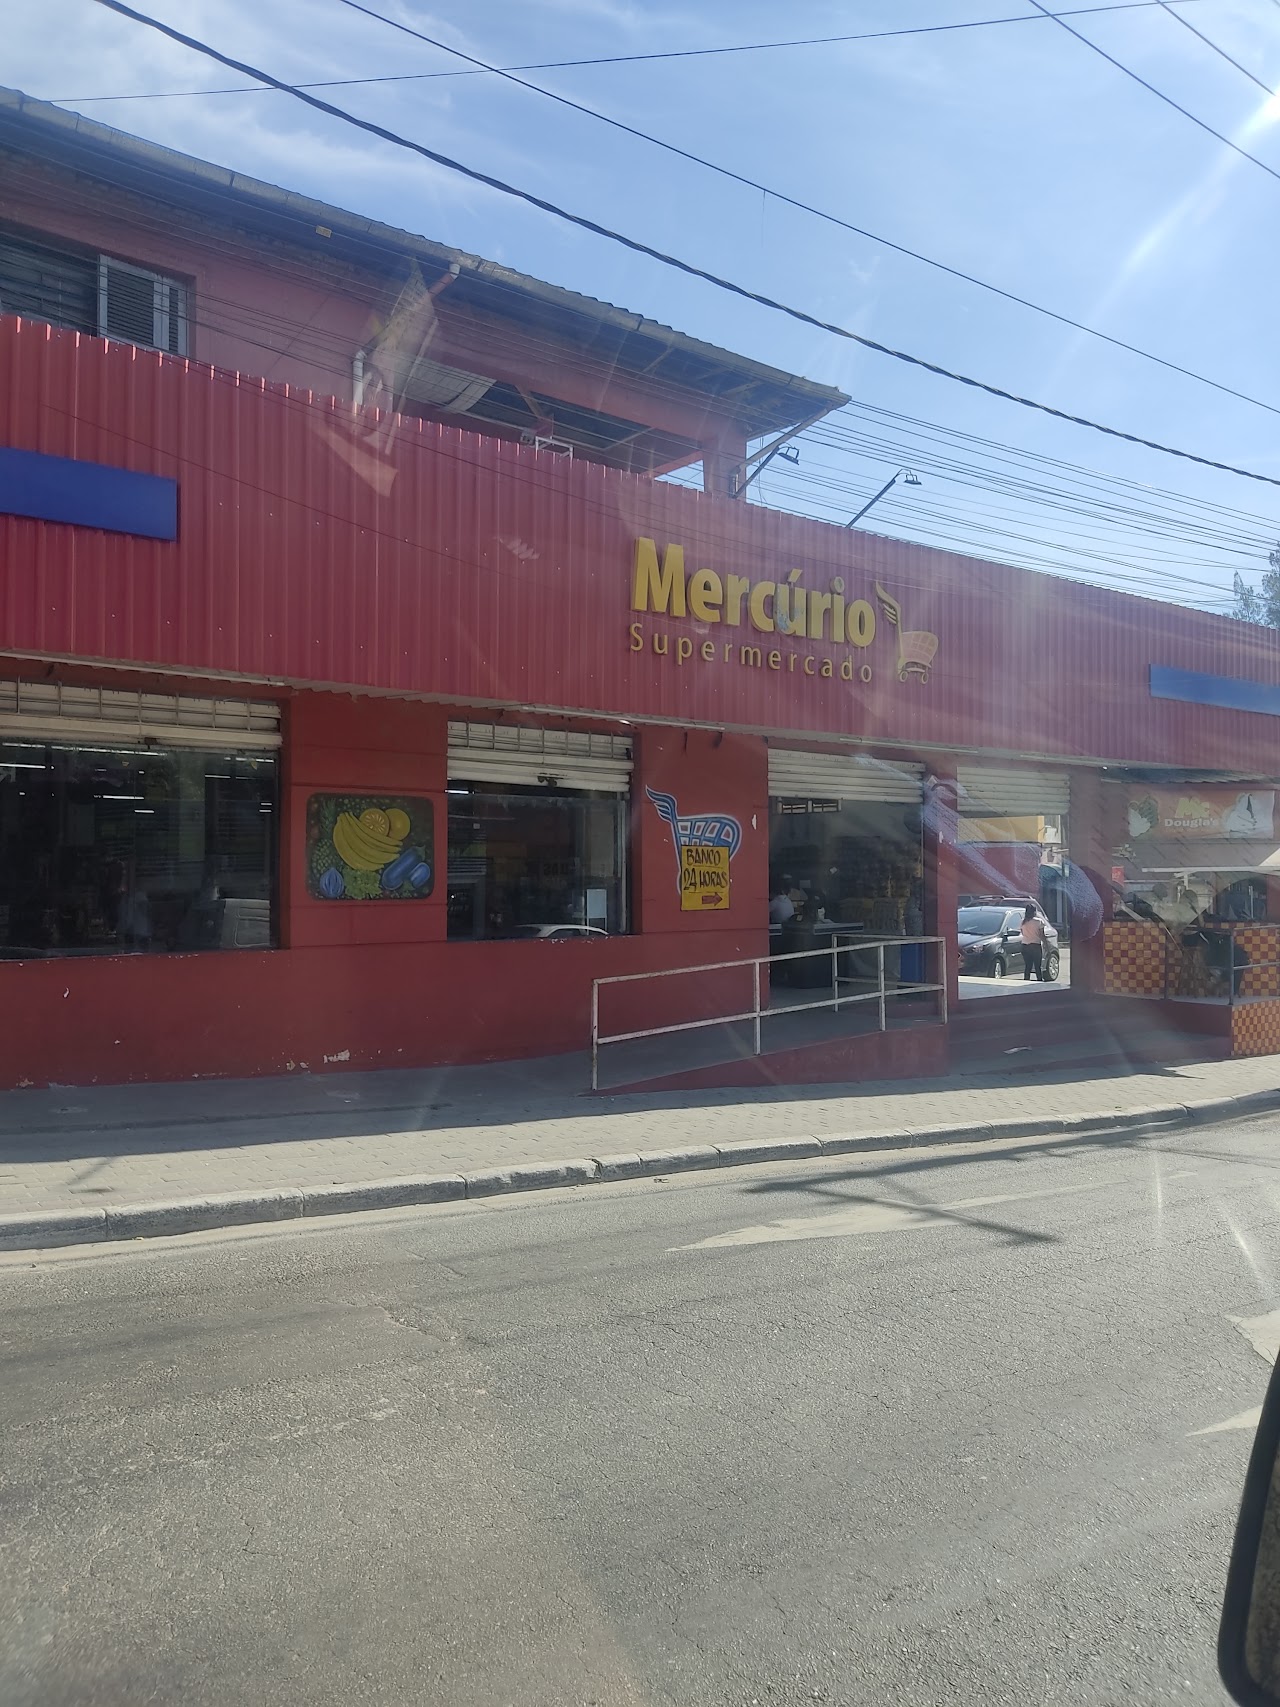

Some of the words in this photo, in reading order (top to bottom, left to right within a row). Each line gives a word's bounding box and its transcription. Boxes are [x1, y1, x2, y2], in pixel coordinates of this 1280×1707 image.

[632, 536, 876, 648] Mercúrio
[630, 622, 873, 683] Supermercado
[686, 849, 721, 866] BANCO
[683, 867, 698, 891] 24
[699, 870, 728, 889] HORAS
